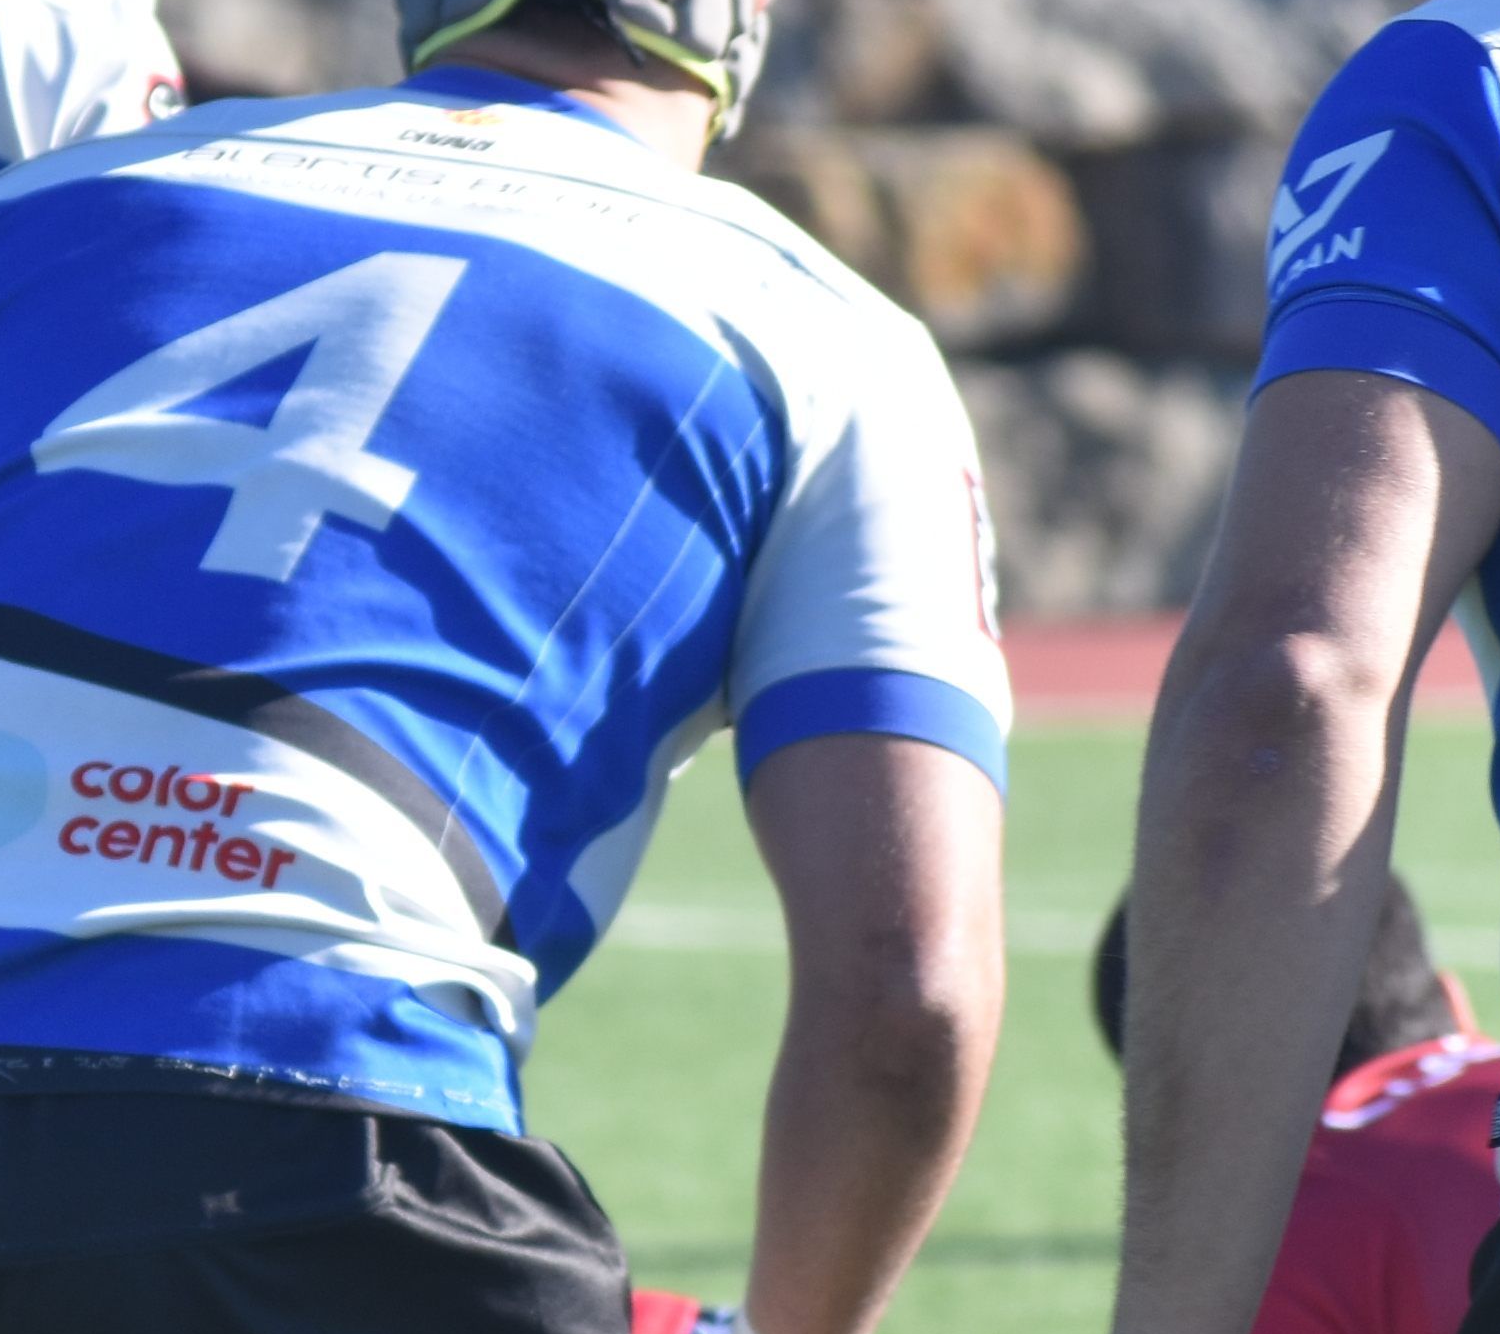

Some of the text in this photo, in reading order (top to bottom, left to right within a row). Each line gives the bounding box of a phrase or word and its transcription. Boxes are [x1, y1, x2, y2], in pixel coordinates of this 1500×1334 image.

[31, 251, 470, 582] 4
[70, 760, 256, 817] color
[58, 815, 297, 889] center
